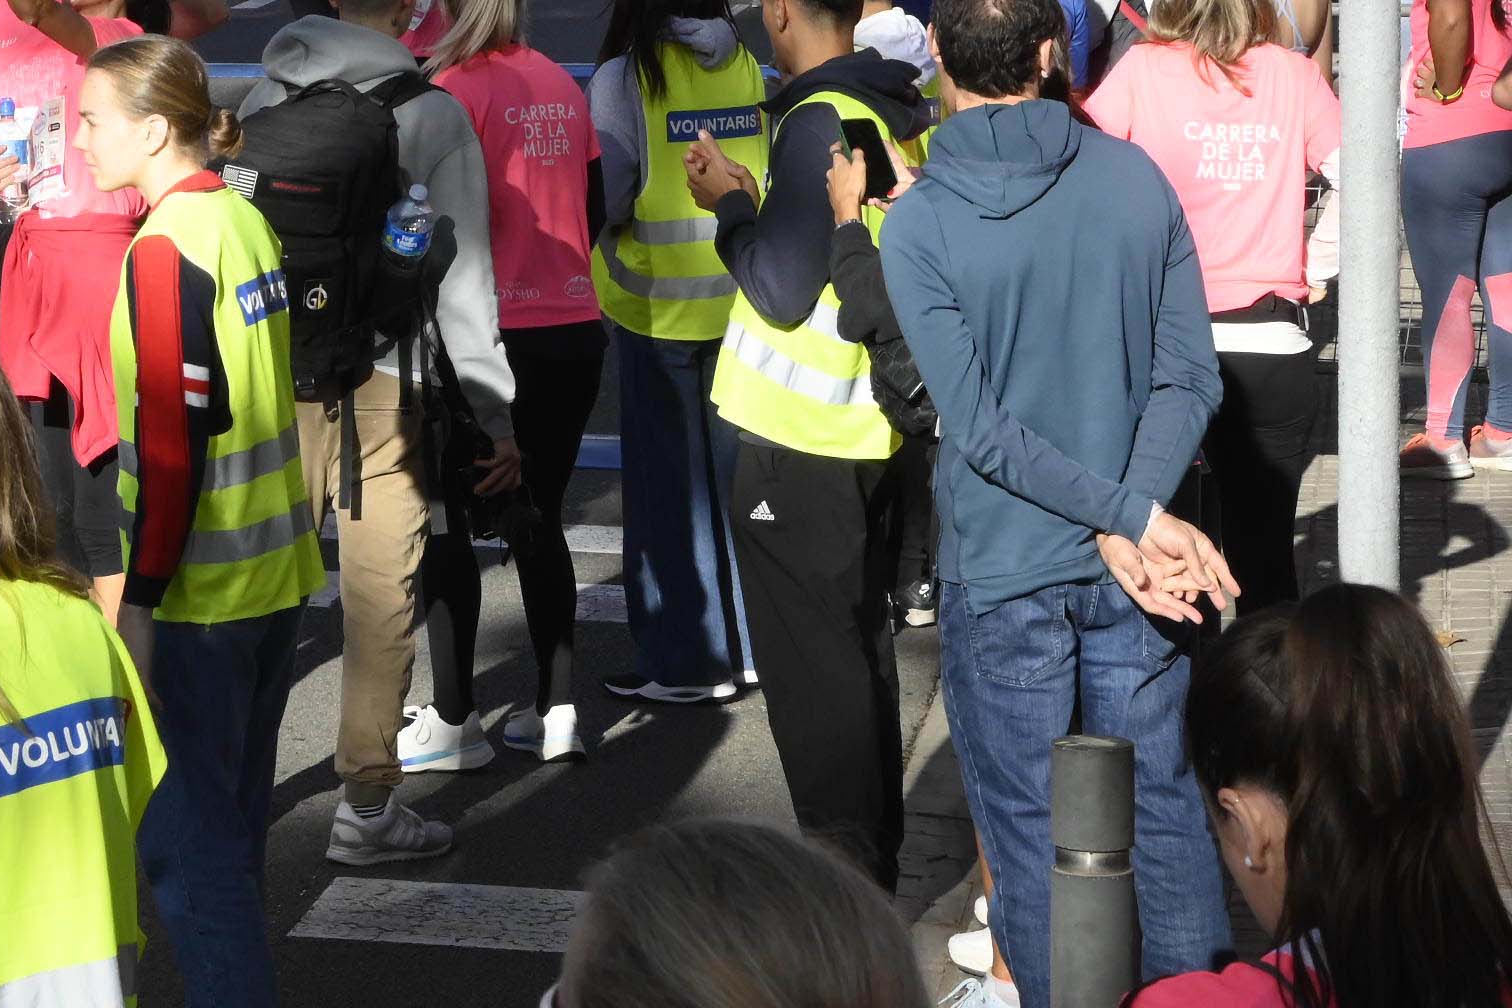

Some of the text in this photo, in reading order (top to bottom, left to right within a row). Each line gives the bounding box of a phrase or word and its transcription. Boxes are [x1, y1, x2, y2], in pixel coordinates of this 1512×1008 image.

[505, 104, 578, 125] CARRERA
[524, 121, 567, 140] DE LA
[670, 114, 758, 135] VOLUNTARIS
[1184, 121, 1281, 141] CARRERA
[523, 140, 571, 159] MUJER
[1201, 143, 1264, 161] DE LA
[1196, 161, 1265, 181] MUJER
[750, 513, 775, 521] adidas
